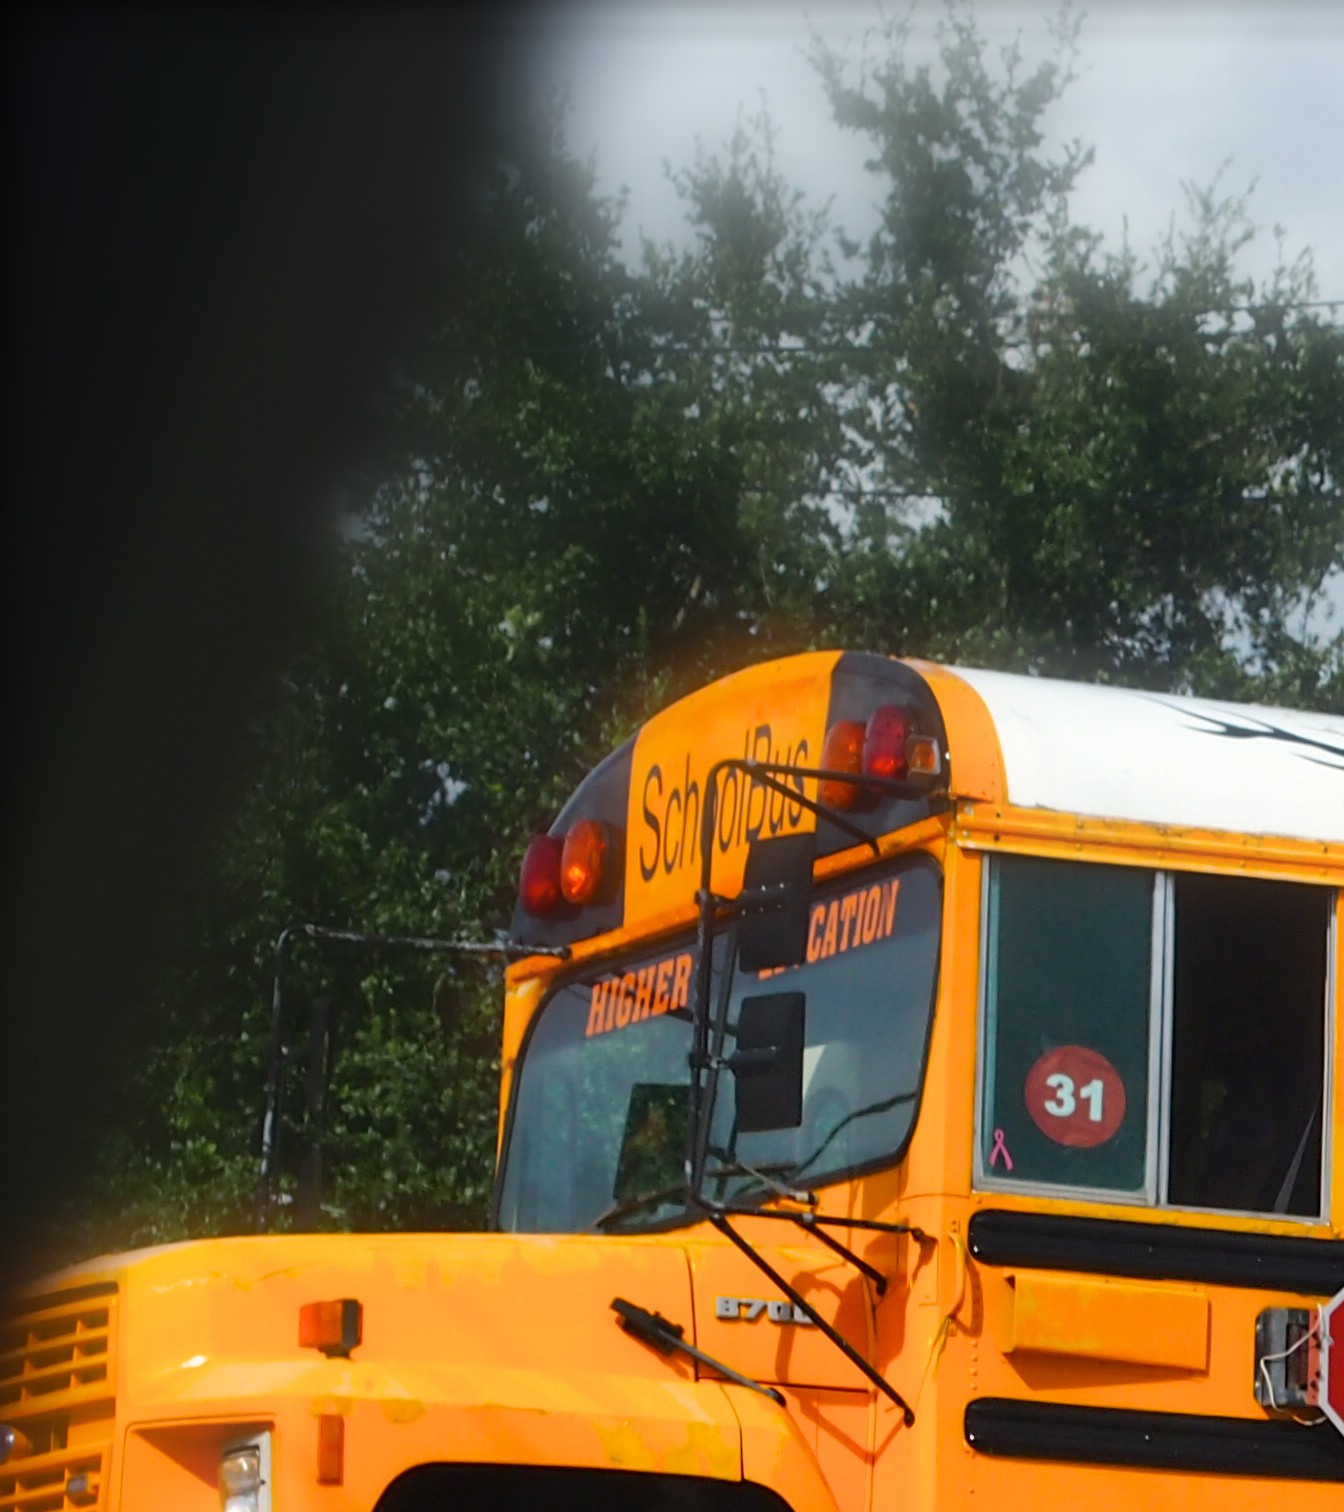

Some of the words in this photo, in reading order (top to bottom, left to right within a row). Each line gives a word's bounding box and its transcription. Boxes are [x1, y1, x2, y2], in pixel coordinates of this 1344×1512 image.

[639, 723, 808, 882] ScholBus
[586, 953, 692, 1037] HIGHER
[758, 878, 899, 981] CATION
[1044, 1073, 1104, 1122] 31
